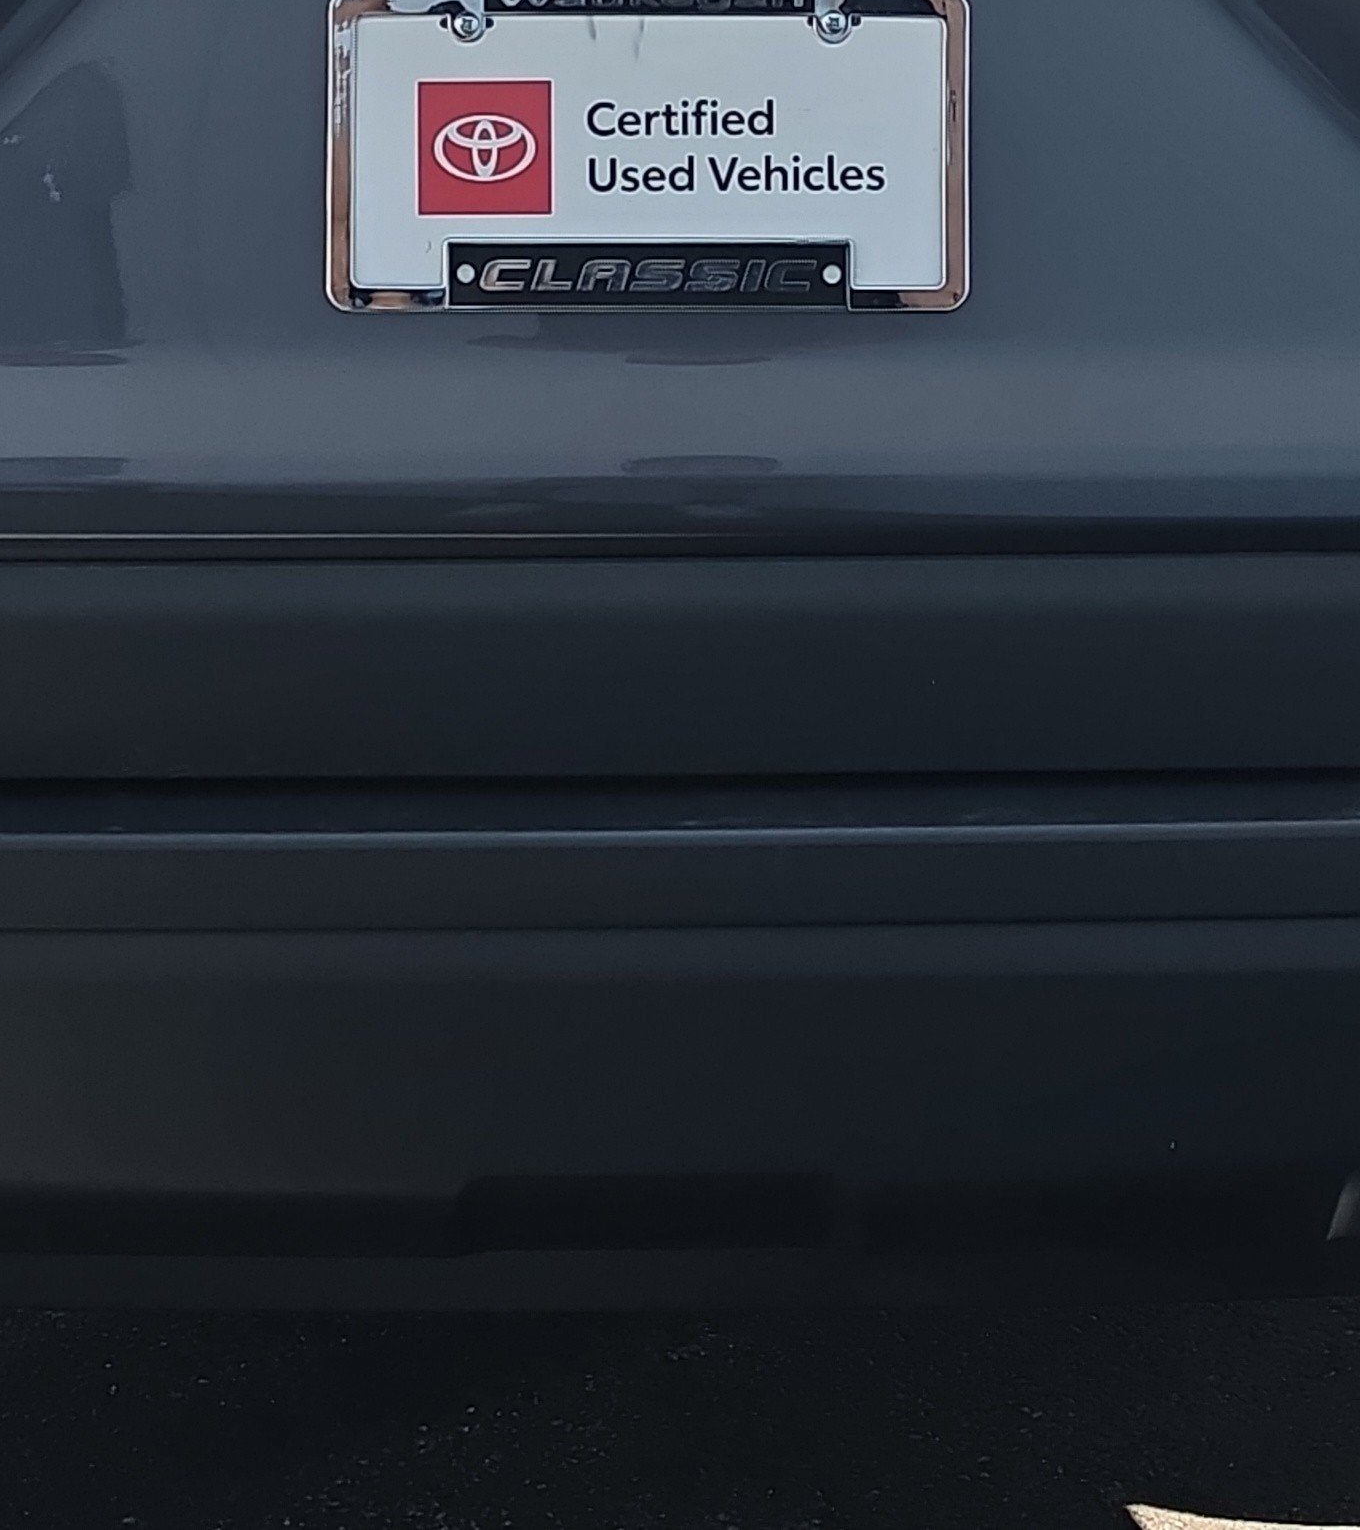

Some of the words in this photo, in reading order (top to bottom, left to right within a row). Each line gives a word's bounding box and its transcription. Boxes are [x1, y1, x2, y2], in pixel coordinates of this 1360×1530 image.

[586, 99, 775, 137] Certified
[588, 155, 695, 192] Used
[707, 155, 887, 192] Vehicles
[478, 258, 818, 293] CLASSIC
